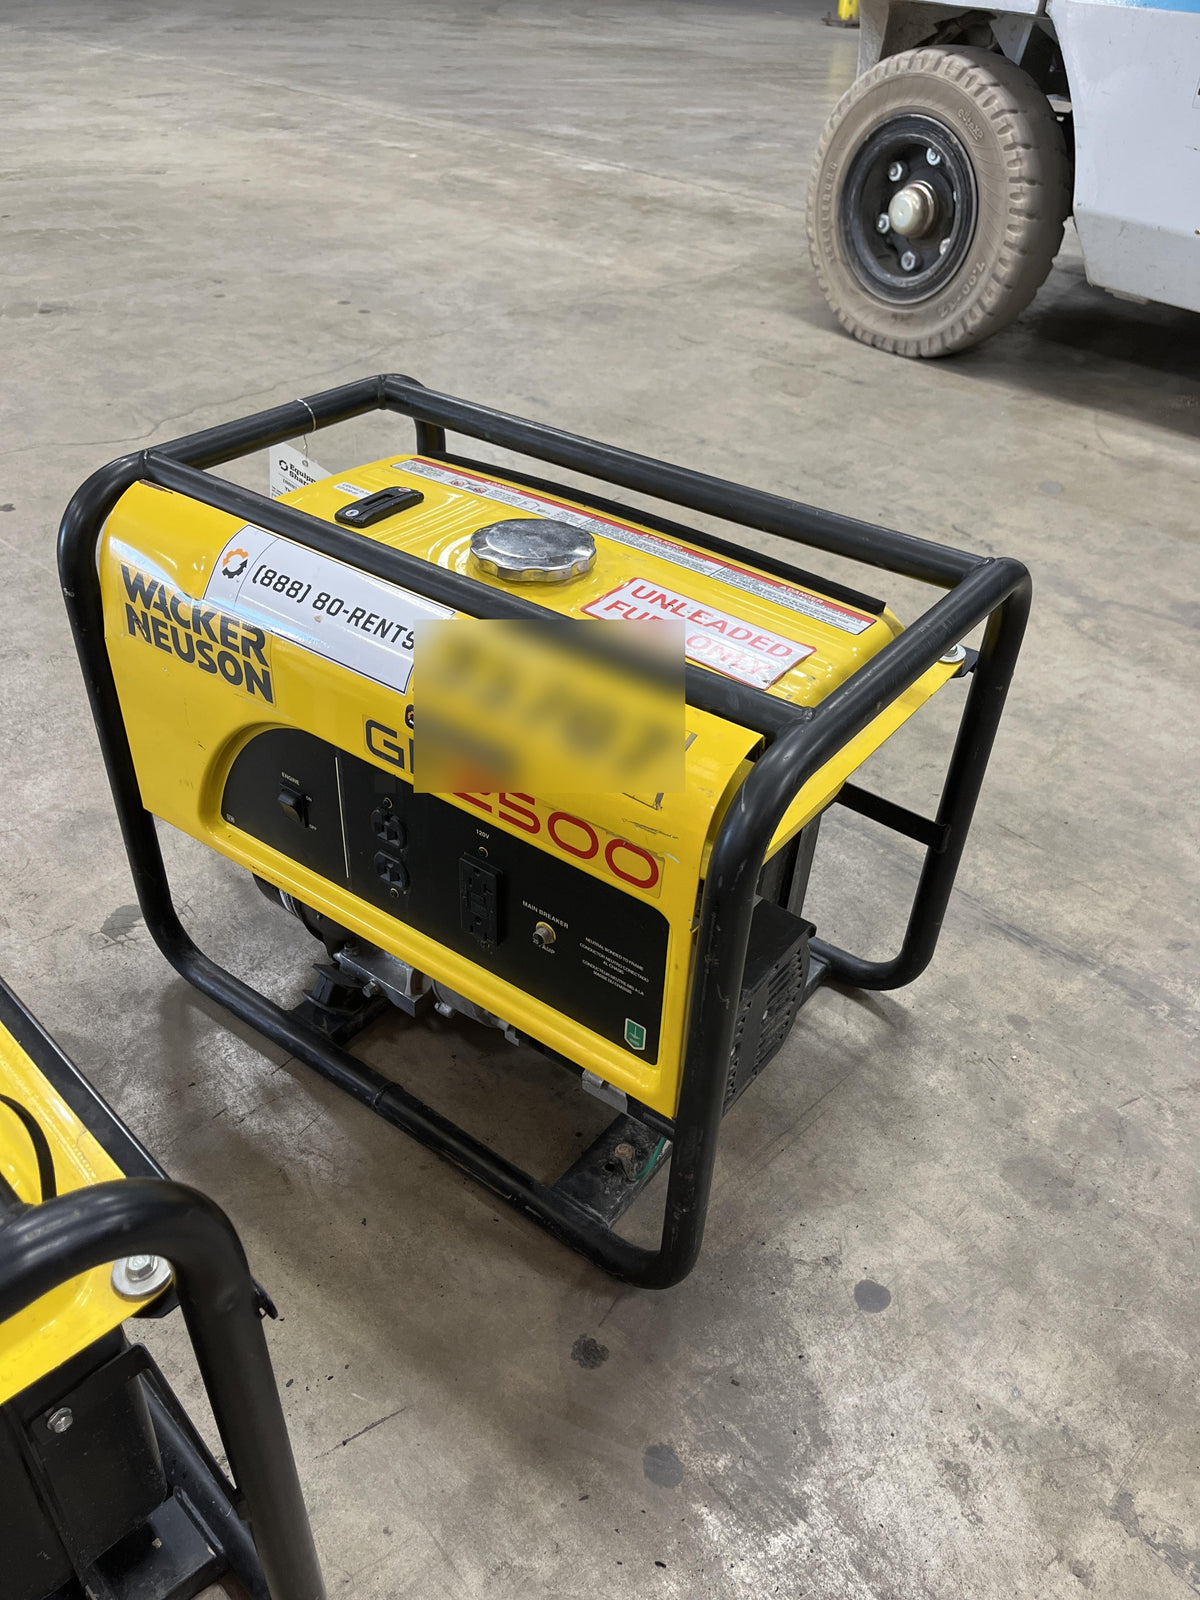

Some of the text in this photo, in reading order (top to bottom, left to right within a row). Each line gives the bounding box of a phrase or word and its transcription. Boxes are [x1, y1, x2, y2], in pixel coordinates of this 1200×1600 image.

[120, 564, 271, 668] WACKER
[251, 563, 414, 650] (888) 80-RENTS
[604, 600, 665, 620] FU
[631, 585, 793, 658] UNLEADED
[124, 603, 274, 705] NEUSON
[686, 635, 775, 676] ONLY
[365, 719, 414, 774] G
[281, 771, 301, 786] ENGINE
[476, 828, 490, 840] 120V
[522, 900, 569, 929] MAIN BREAKER
